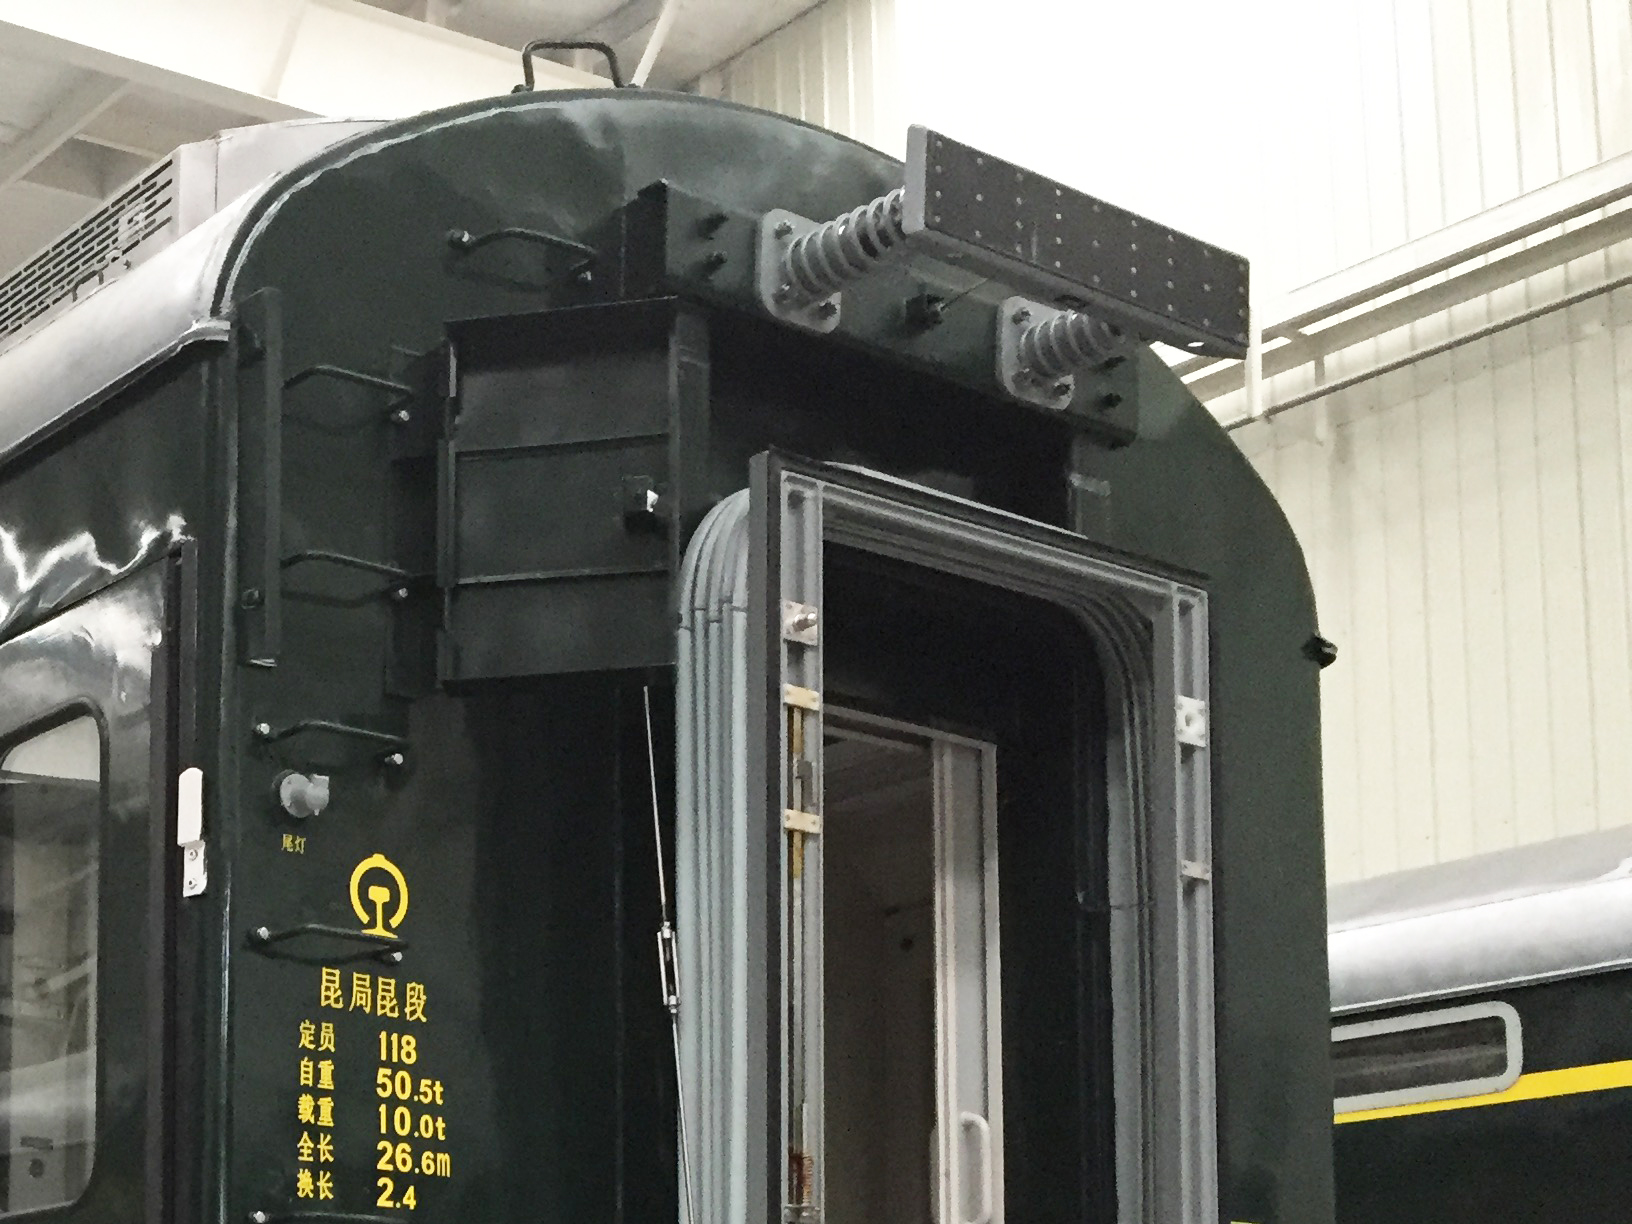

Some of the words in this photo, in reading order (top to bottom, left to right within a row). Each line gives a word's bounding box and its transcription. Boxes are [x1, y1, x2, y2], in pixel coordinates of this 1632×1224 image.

[281, 833, 307, 855] 尾灯
[319, 966, 428, 1023] 昆局昆段
[298, 1019, 336, 1053] 定员
[378, 1030, 417, 1065] 118
[299, 1057, 336, 1091] 自重
[375, 1068, 444, 1106] 50.5t
[297, 1091, 335, 1128] 载重
[378, 1104, 447, 1142] 10.0t
[297, 1131, 335, 1163] 全长
[376, 1140, 452, 1178] 26.6m
[296, 1167, 335, 1200] 换长
[376, 1176, 418, 1210] 2.4
